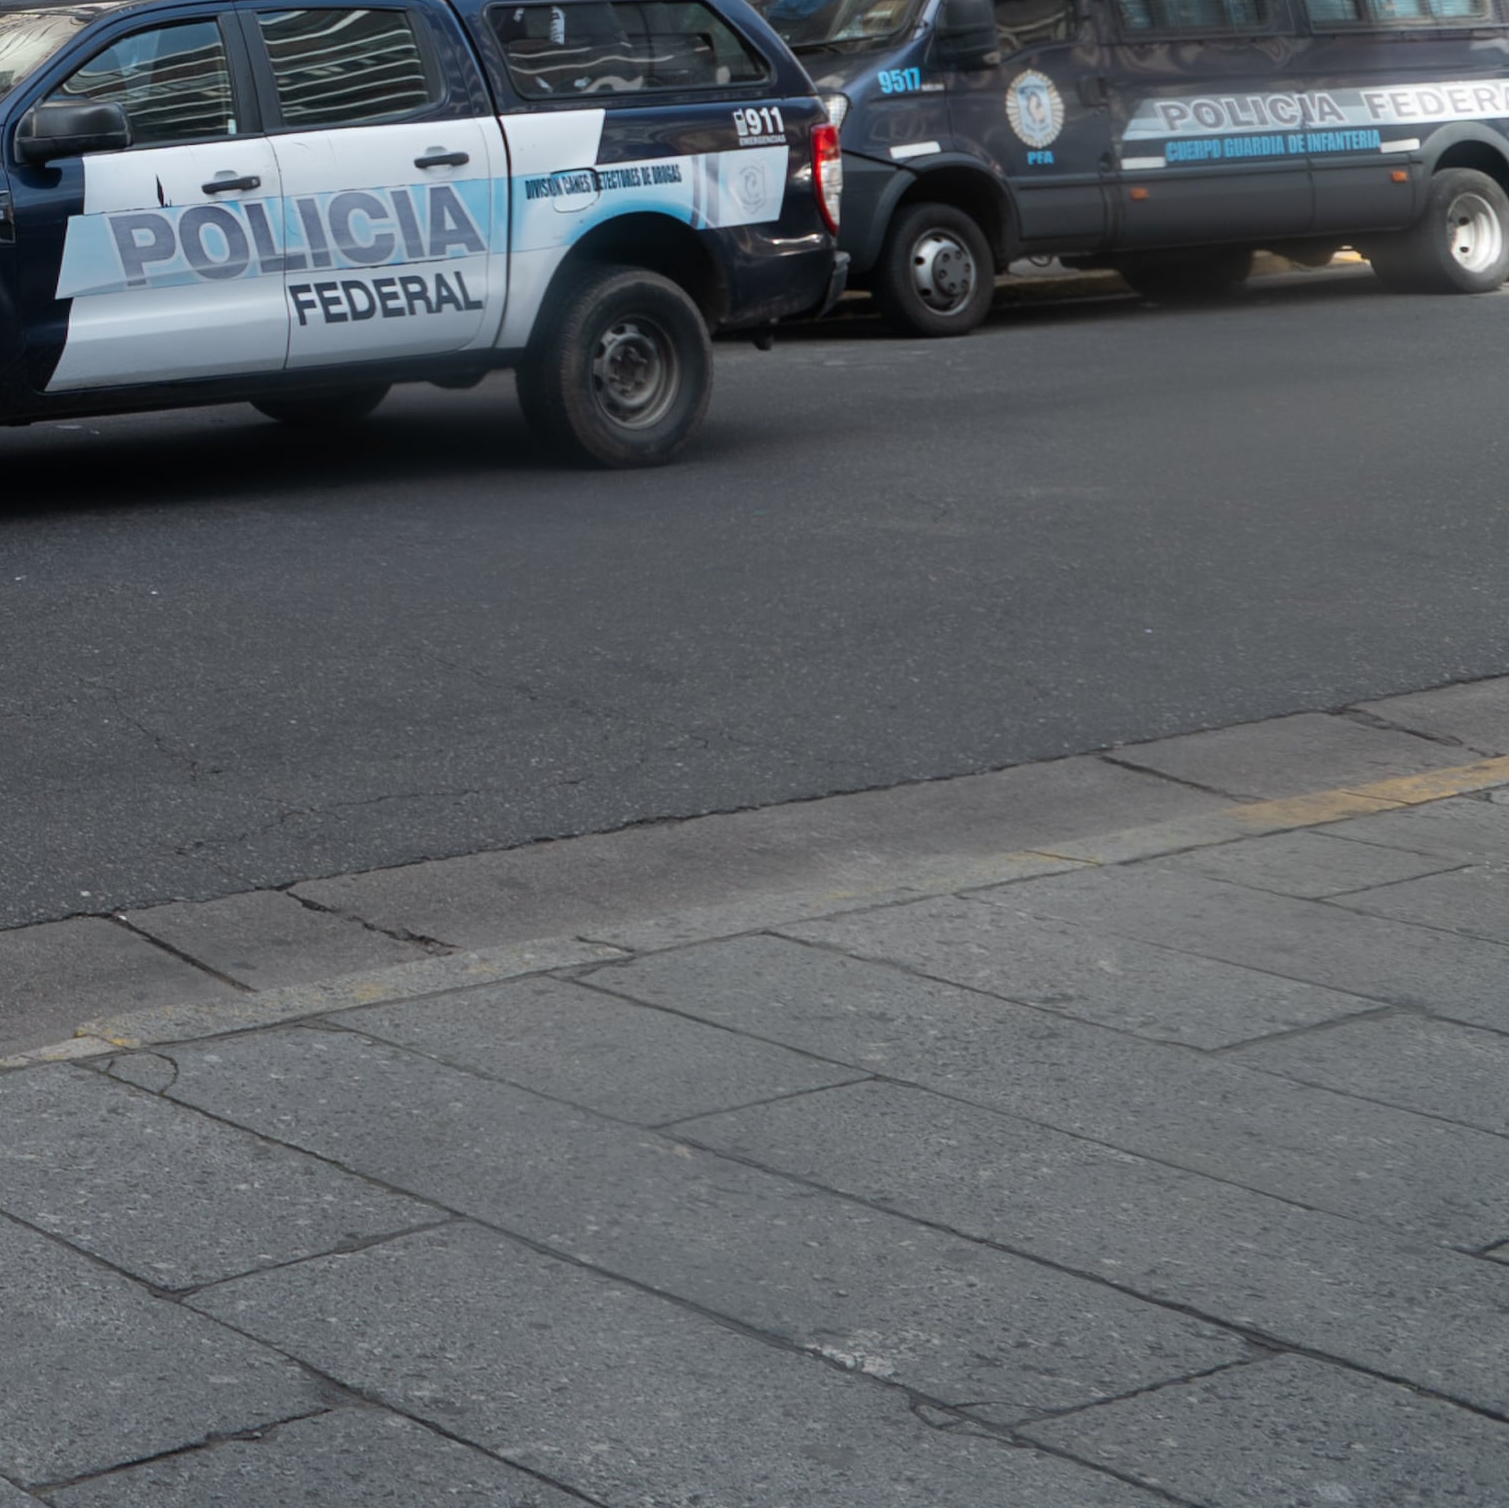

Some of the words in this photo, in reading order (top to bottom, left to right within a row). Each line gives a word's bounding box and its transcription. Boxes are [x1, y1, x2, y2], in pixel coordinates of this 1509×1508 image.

[878, 66, 921, 94] 9517
[745, 106, 785, 135] 911
[1158, 91, 1347, 131] POLICIA
[1362, 84, 1509, 120] FEDER
[1027, 151, 1054, 165] PFA
[1165, 140, 1221, 163] CUERPO
[1225, 135, 1284, 158] GUARDIA
[1288, 133, 1304, 154] DE
[1307, 129, 1381, 152] INFANTERIA
[652, 163, 683, 185] DROGAS
[108, 185, 487, 288] POLICIA
[288, 270, 484, 326] FEDERAL
